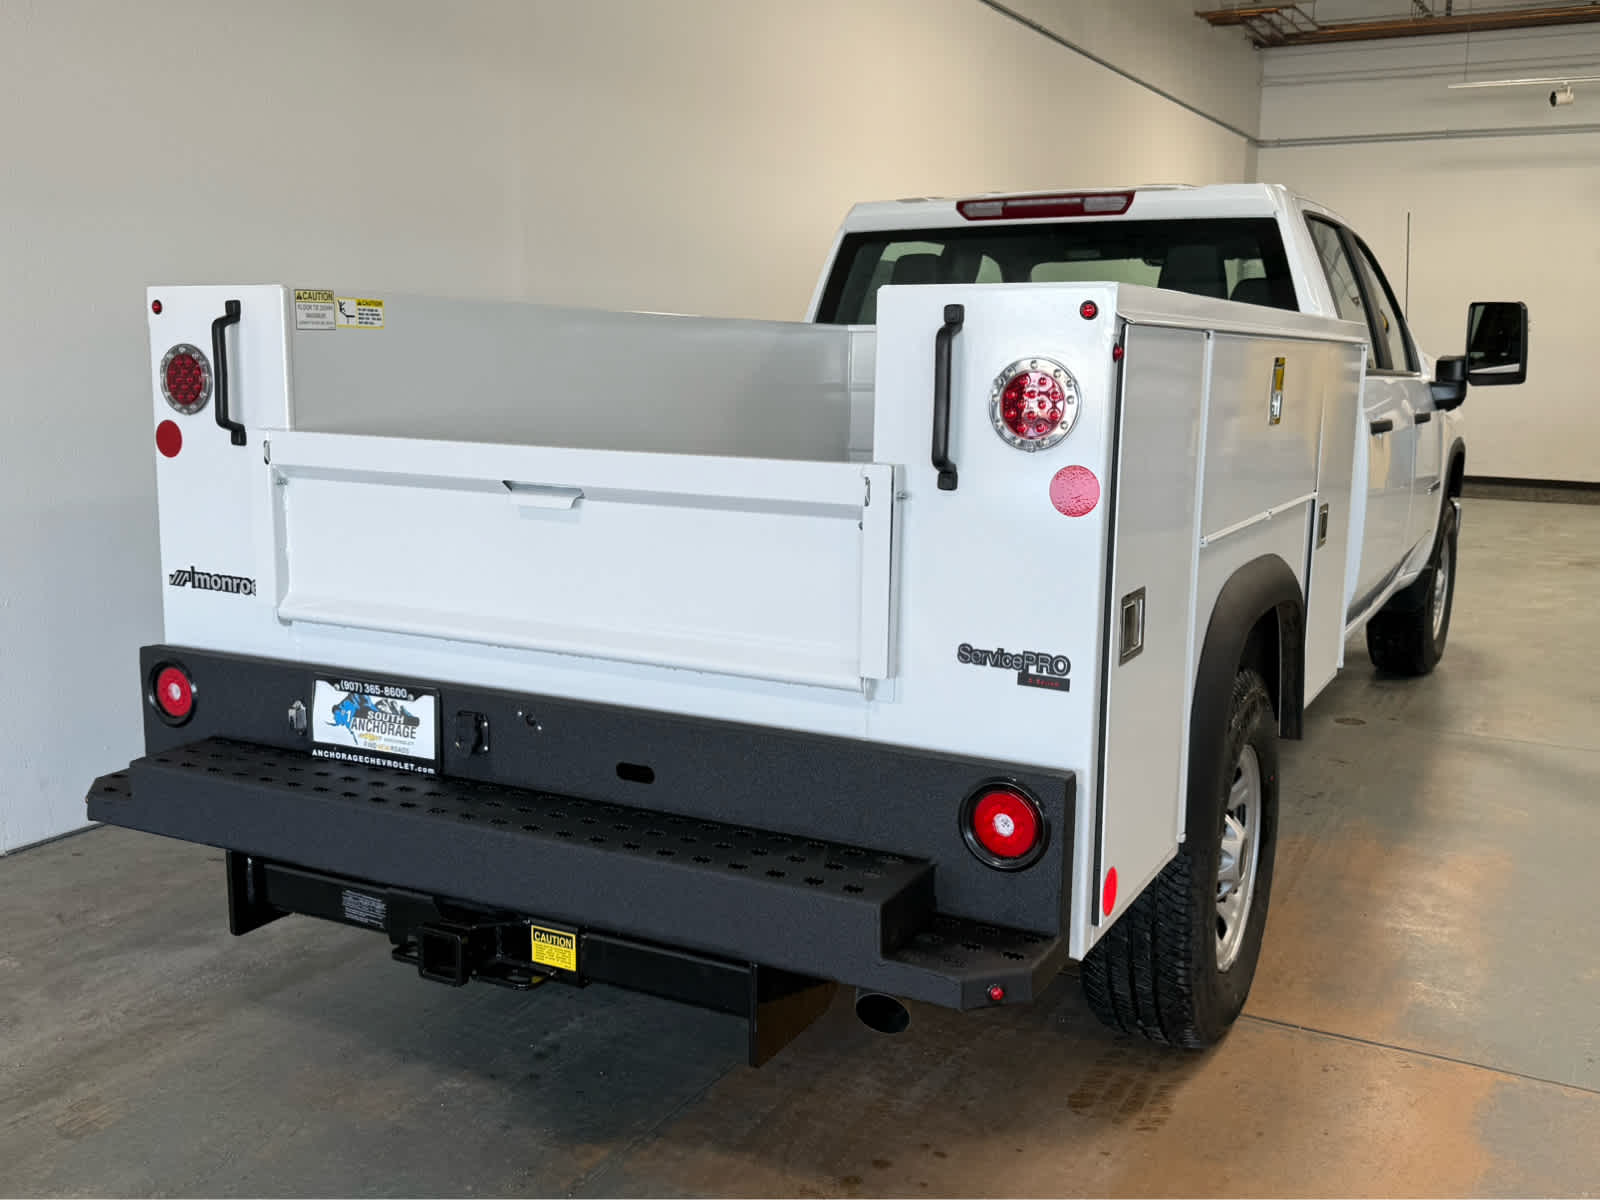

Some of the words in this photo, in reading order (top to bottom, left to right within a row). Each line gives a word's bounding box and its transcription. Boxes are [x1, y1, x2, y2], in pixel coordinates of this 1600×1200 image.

[302, 291, 334, 302] CAUTION
[957, 643, 1071, 677] ServicePRO
[340, 680, 363, 693] (907)
[364, 684, 408, 699] 365-8600
[367, 711, 405, 725] SOUTH
[350, 718, 417, 740] ANCHORAGE
[311, 749, 436, 775] ANCHORAGECHEVROLET.com
[534, 931, 572, 949] CAUTION
